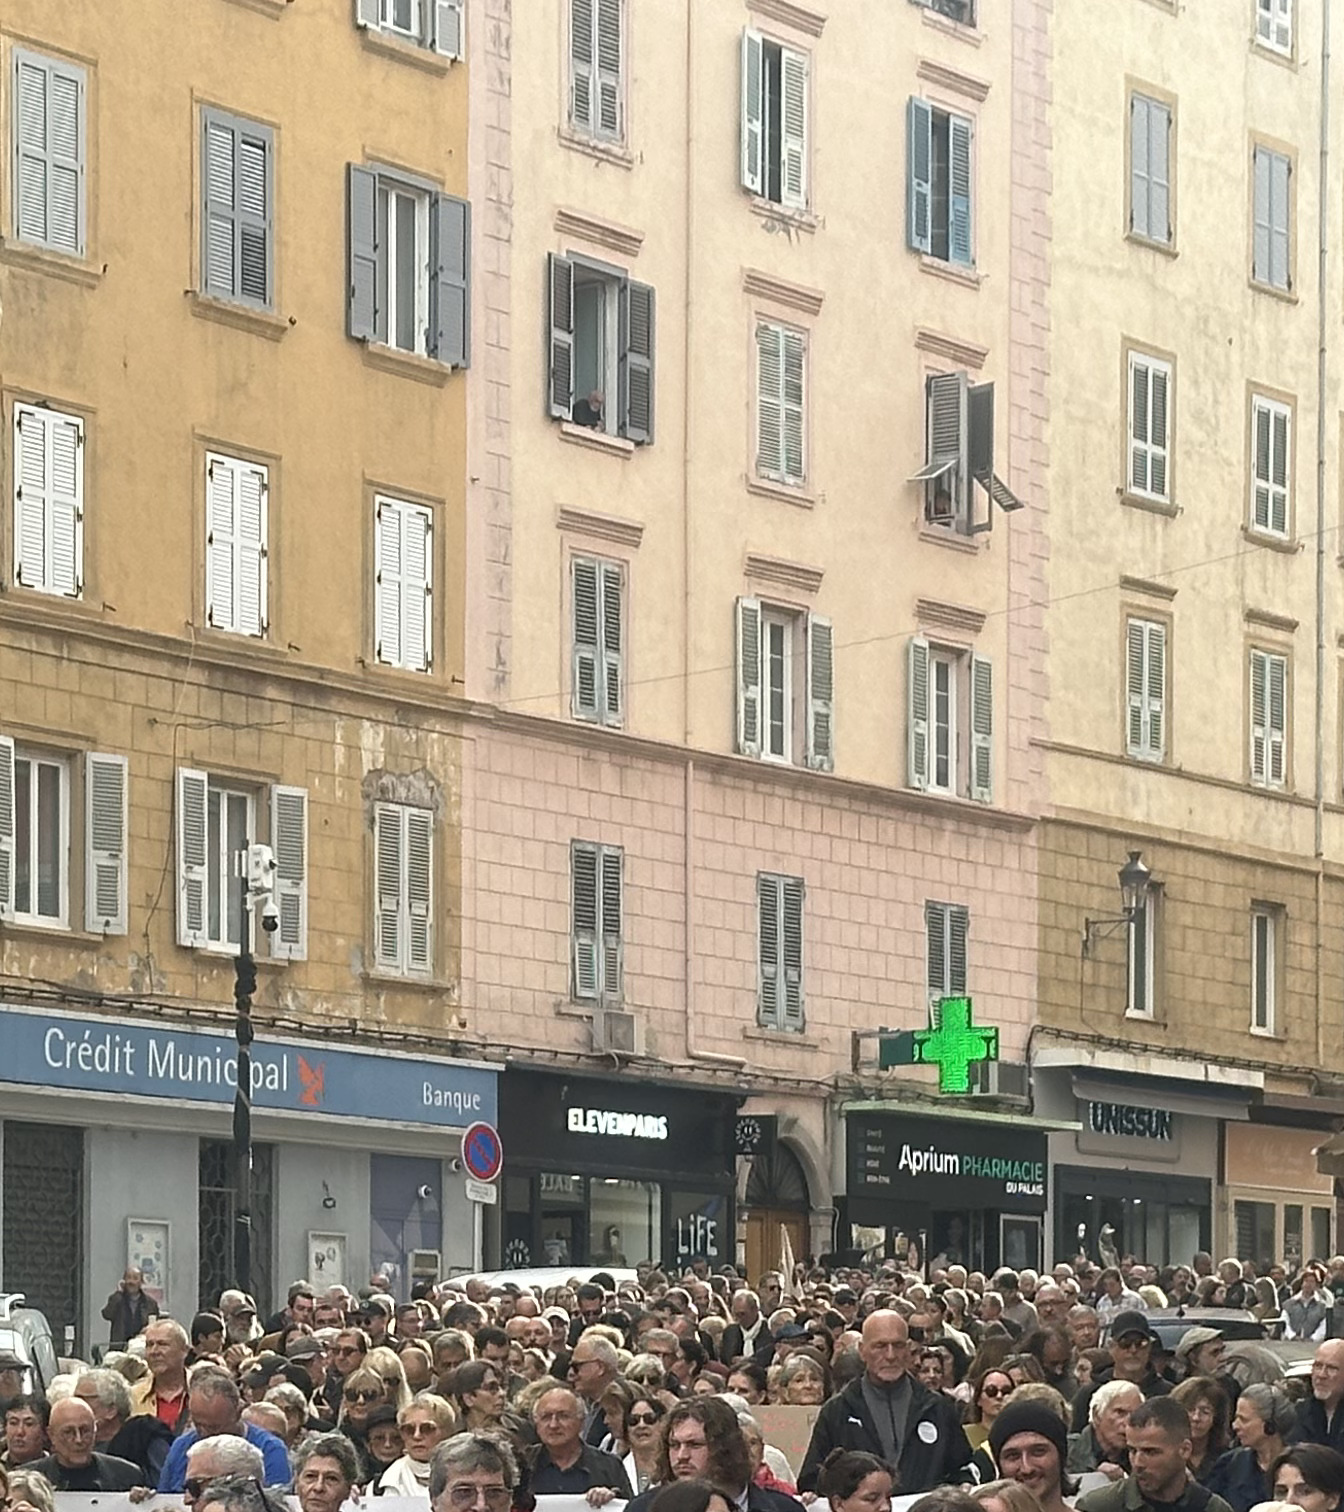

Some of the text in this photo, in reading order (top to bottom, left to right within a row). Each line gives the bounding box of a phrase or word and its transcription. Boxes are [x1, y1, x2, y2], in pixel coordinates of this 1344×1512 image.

[43, 1027, 289, 1098] Crédit Municpal
[422, 1081, 481, 1116] Banque
[567, 1107, 668, 1141] ELEVENPARIS
[898, 1143, 960, 1177] Aprium
[963, 1154, 1044, 1183] PHARMACIE
[1006, 1181, 1044, 1196] DU PALAIS
